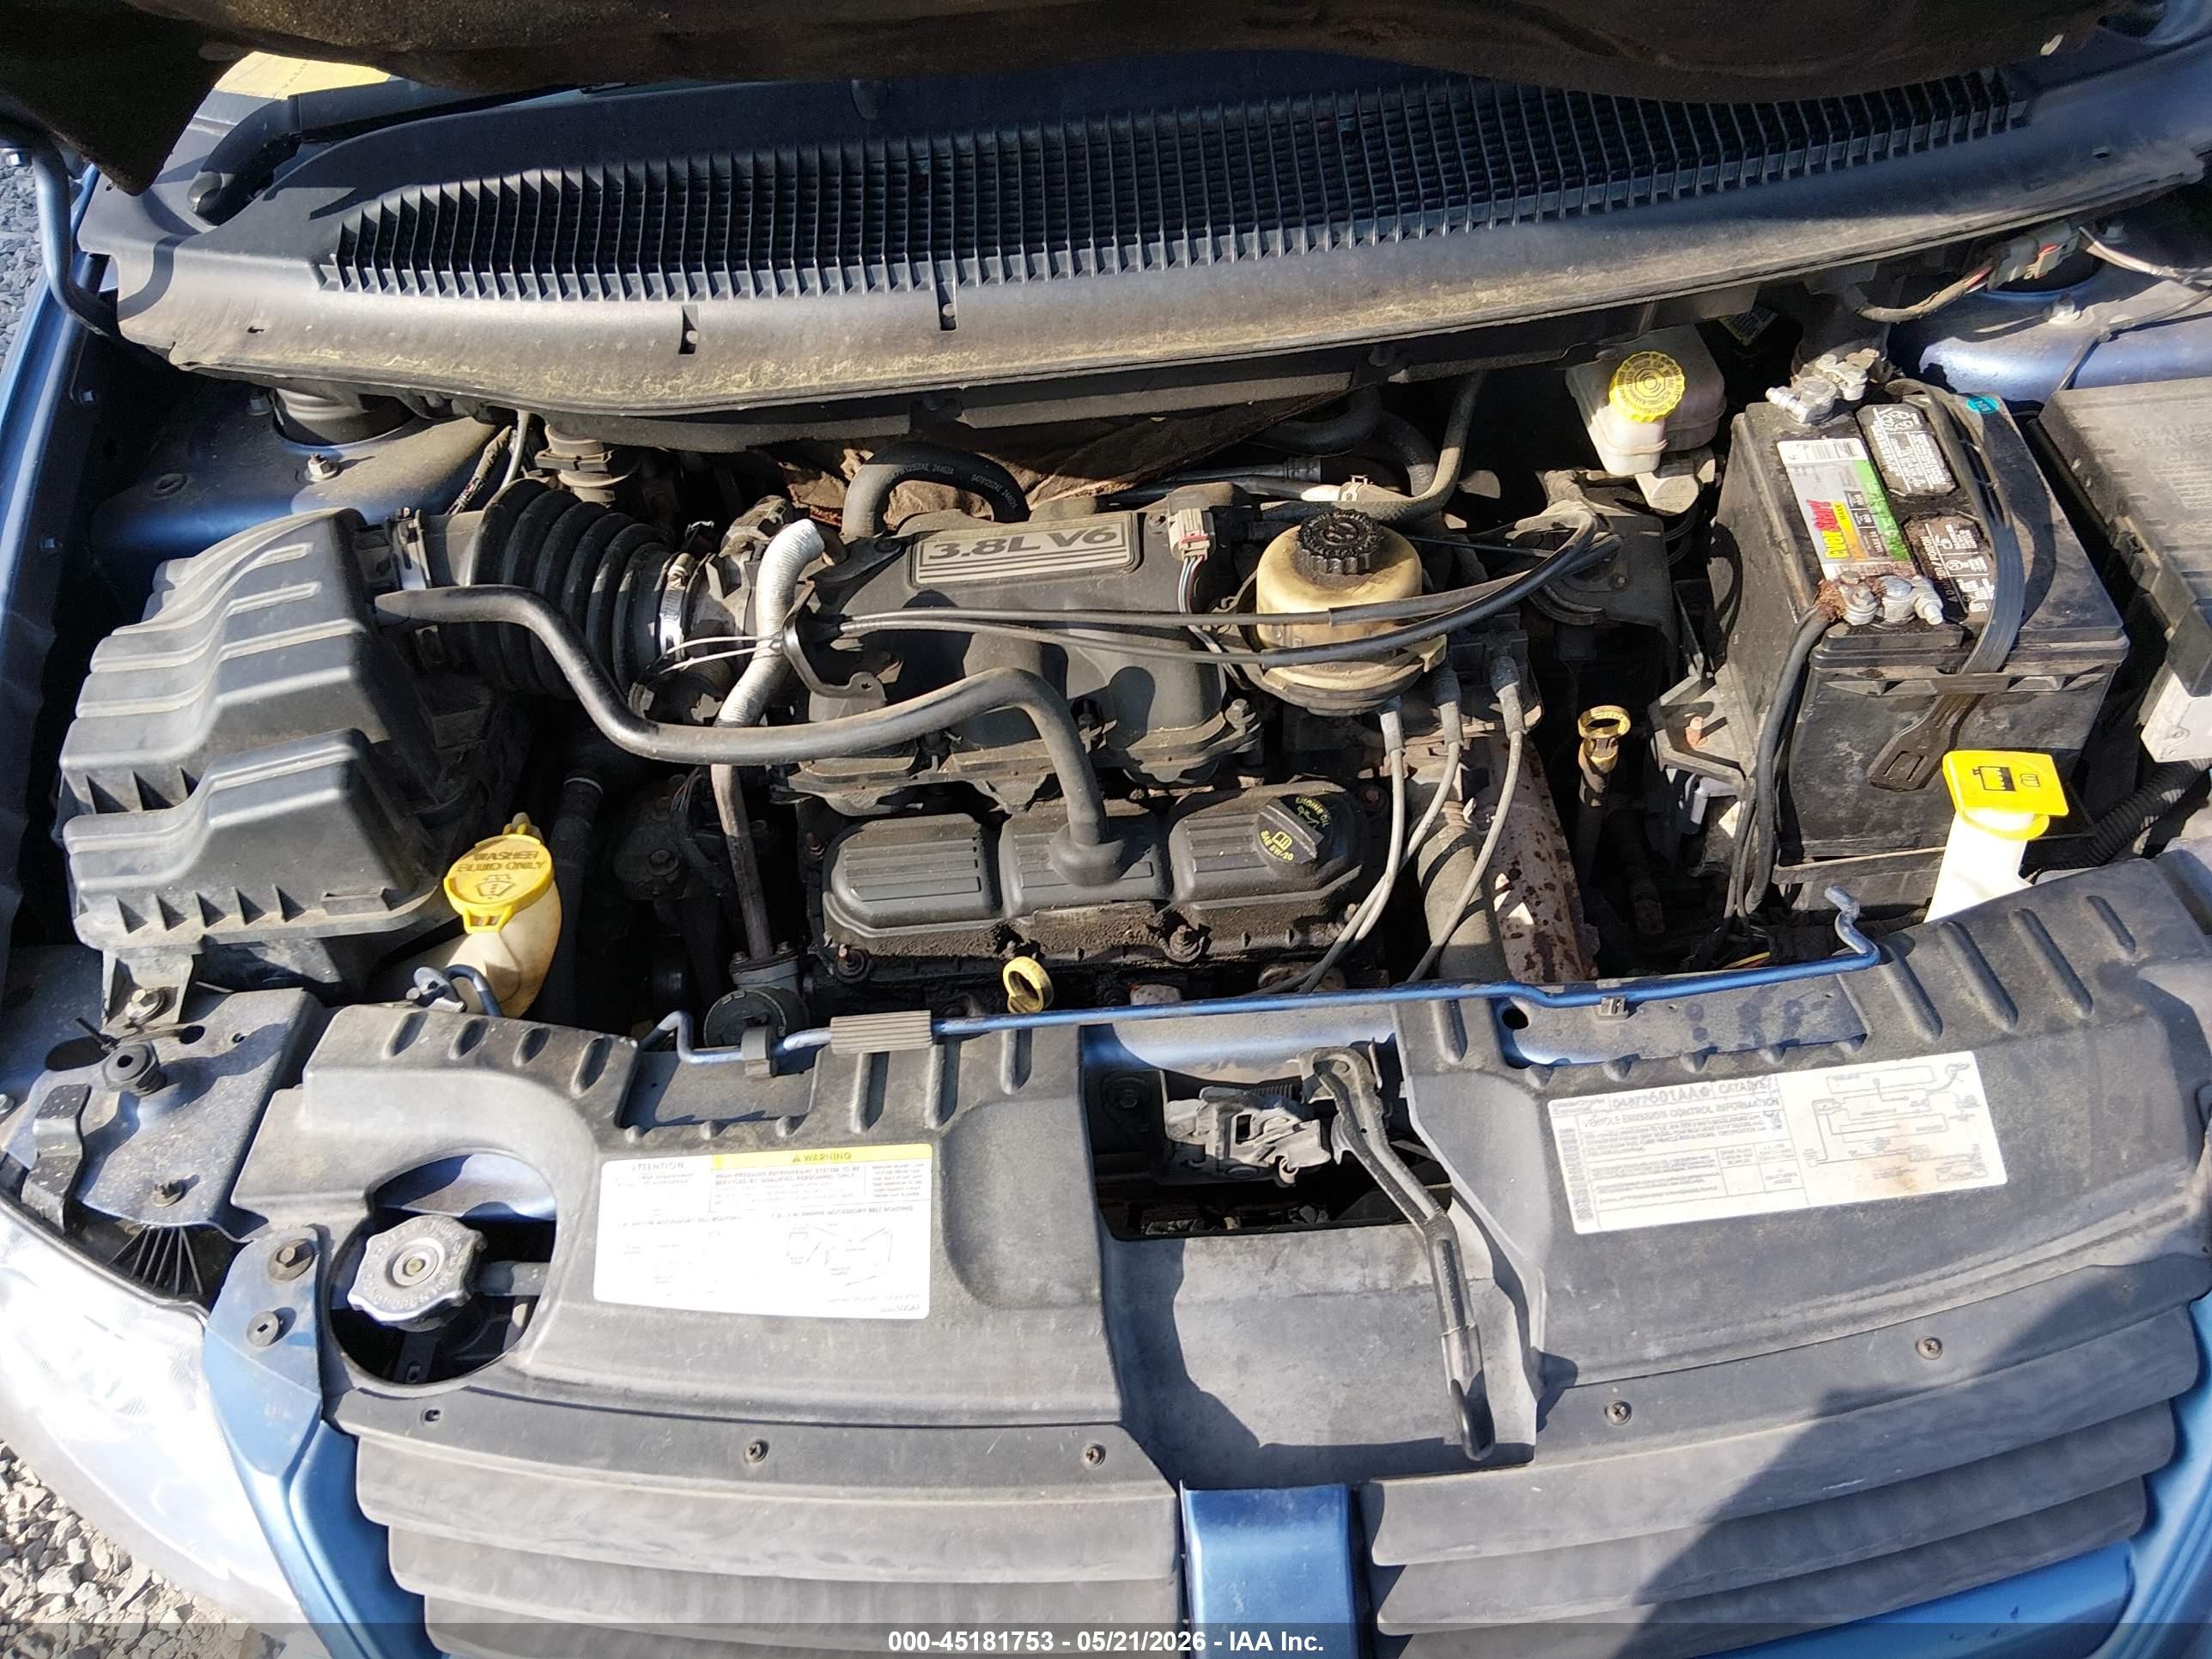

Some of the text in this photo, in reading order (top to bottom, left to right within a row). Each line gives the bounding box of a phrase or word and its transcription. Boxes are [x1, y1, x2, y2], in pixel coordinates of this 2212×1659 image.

[928, 526, 1118, 559] 3.8L V6
[1319, 813, 1331, 829] OIL
[472, 850, 539, 861] WASHER
[457, 860, 548, 873] FLUID ONLY
[1622, 1110, 1668, 1123] EMISSION
[1669, 1105, 1714, 1118] CONTROL
[1715, 1098, 1779, 1113] INFORMATION
[803, 1152, 853, 1163] WARNING
[632, 1162, 685, 1172] ATTENTION
